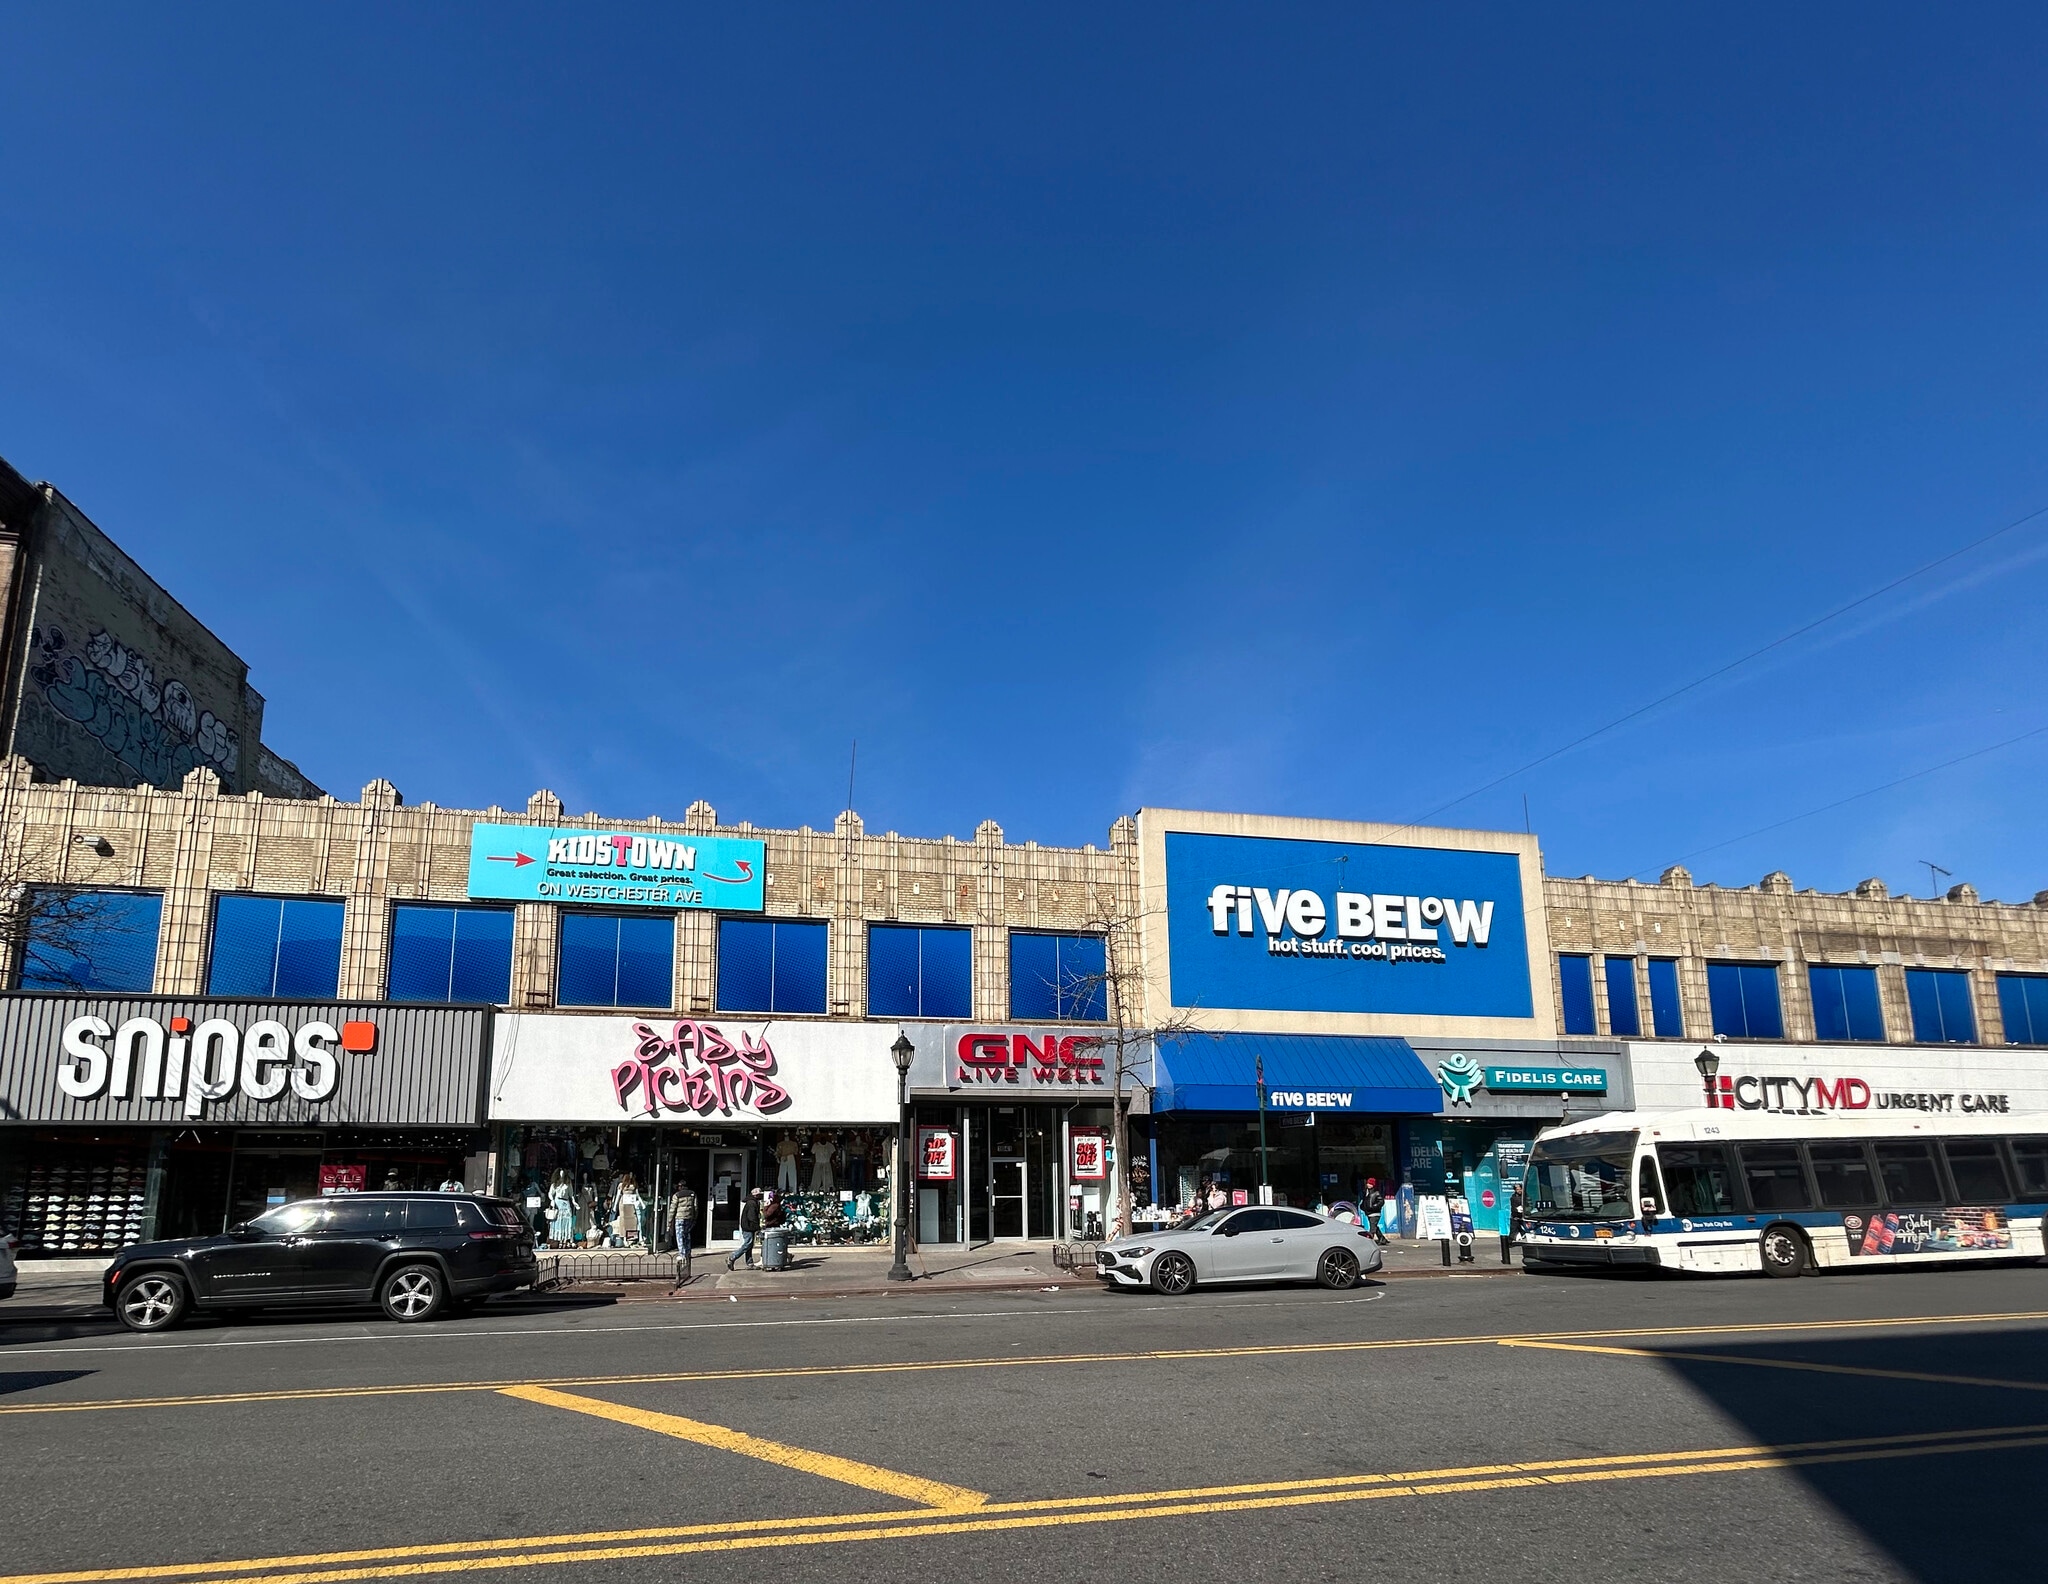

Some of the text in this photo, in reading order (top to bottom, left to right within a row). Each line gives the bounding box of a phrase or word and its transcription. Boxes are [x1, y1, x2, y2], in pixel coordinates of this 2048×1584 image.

[548, 835, 697, 871] KIDSTOWN
[547, 868, 693, 885] Great selection. Great prices.
[537, 882, 703, 903] ON WESTCHESTER AVE
[1207, 884, 1326, 939] five
[1268, 937, 1446, 962] hot stuff. cool prices.
[632, 1019, 774, 1070] EASY
[957, 1033, 1104, 1066] GNC
[58, 1016, 339, 1116] snipes
[958, 1066, 1103, 1082] LIVE WELL
[1495, 1070, 1602, 1085] FIDELIS CARE
[611, 1060, 790, 1113] PICKINS
[1733, 1075, 2011, 1113] CITYMD URGENT CARE
[1271, 1092, 1304, 1106] five
[1704, 1126, 1720, 1134] 1243
[701, 1136, 720, 1144] 1039
[1076, 1142, 1097, 1154] 50%
[923, 1151, 946, 1164] OFF
[1076, 1153, 1097, 1165] OFF
[1410, 1146, 1440, 1157] IDELIS
[323, 1174, 361, 1183] SALE
